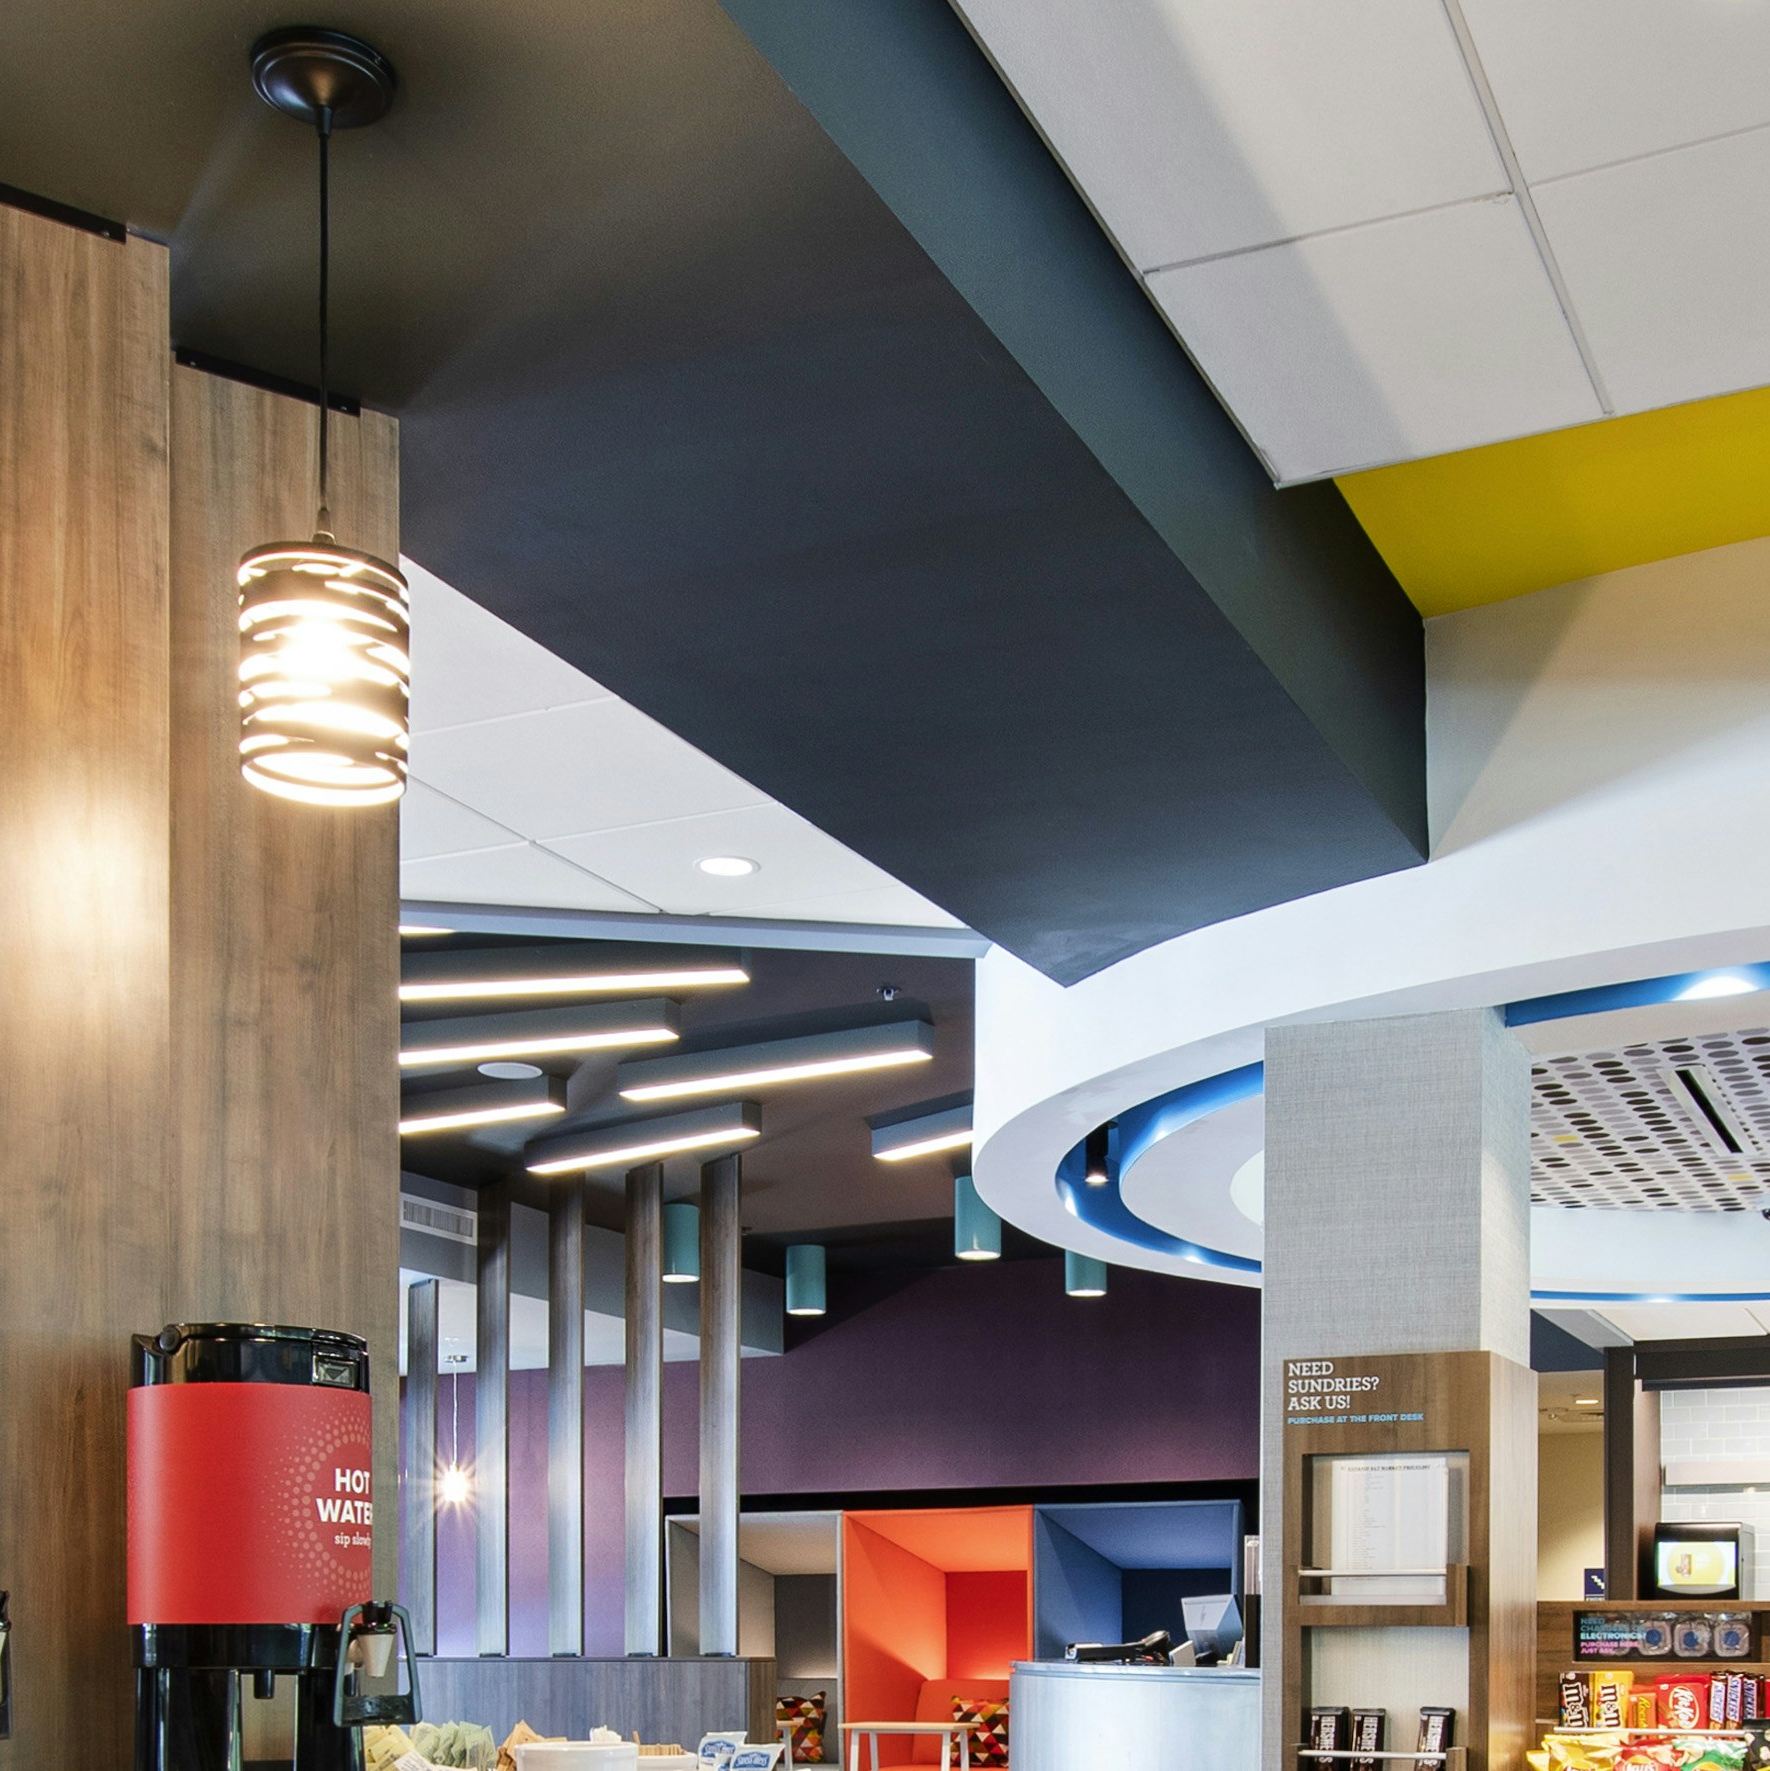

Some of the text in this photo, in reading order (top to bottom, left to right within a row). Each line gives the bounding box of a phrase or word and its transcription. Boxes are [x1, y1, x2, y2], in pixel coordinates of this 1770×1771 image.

[1288, 1361, 1334, 1377] NEED
[1288, 1376, 1379, 1393] SUNDRIES?
[1287, 1395, 1351, 1411] ASK US!
[1287, 1412, 1424, 1425] PURCHASE AT THE FRONT DESK
[335, 1468, 370, 1494] HOT
[316, 1498, 372, 1525] WATE
[334, 1532, 350, 1548] sip
[1727, 1677, 1742, 1722] SNICKERS
[1319, 1716, 1335, 1763] HERSHES
[1360, 1717, 1378, 1764] HERSHES
[1424, 1716, 1444, 1765] HERSHES
